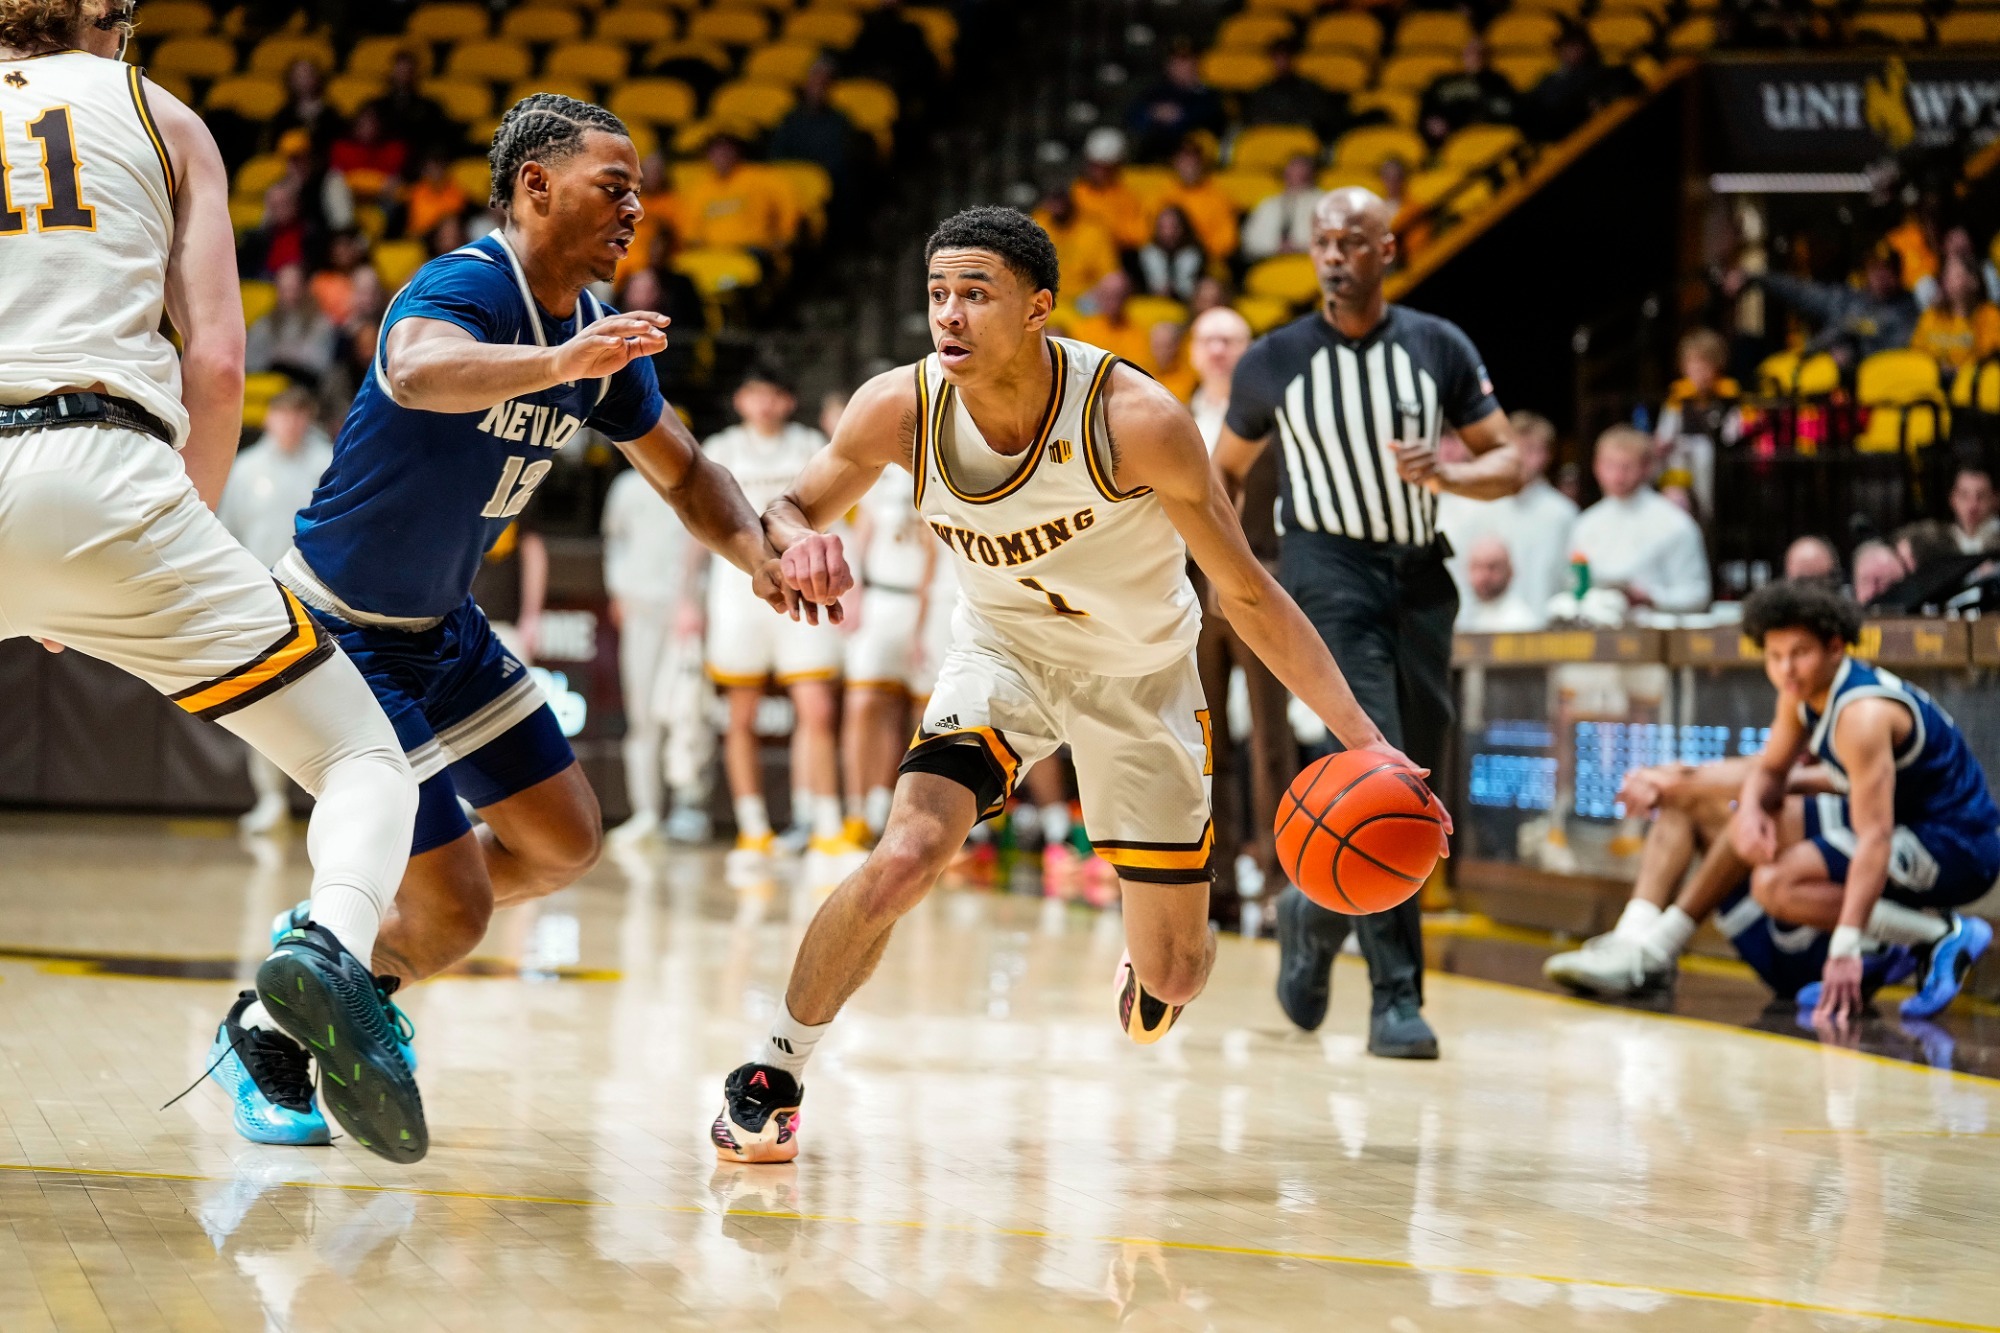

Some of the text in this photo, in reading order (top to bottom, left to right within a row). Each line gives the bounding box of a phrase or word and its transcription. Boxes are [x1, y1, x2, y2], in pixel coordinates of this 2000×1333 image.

[1761, 80, 1862, 129] UNI
[480, 455, 553, 518] 12
[929, 507, 1096, 567] WYOMING
[1016, 576, 1092, 617] 1
[935, 721, 963, 731] adida
